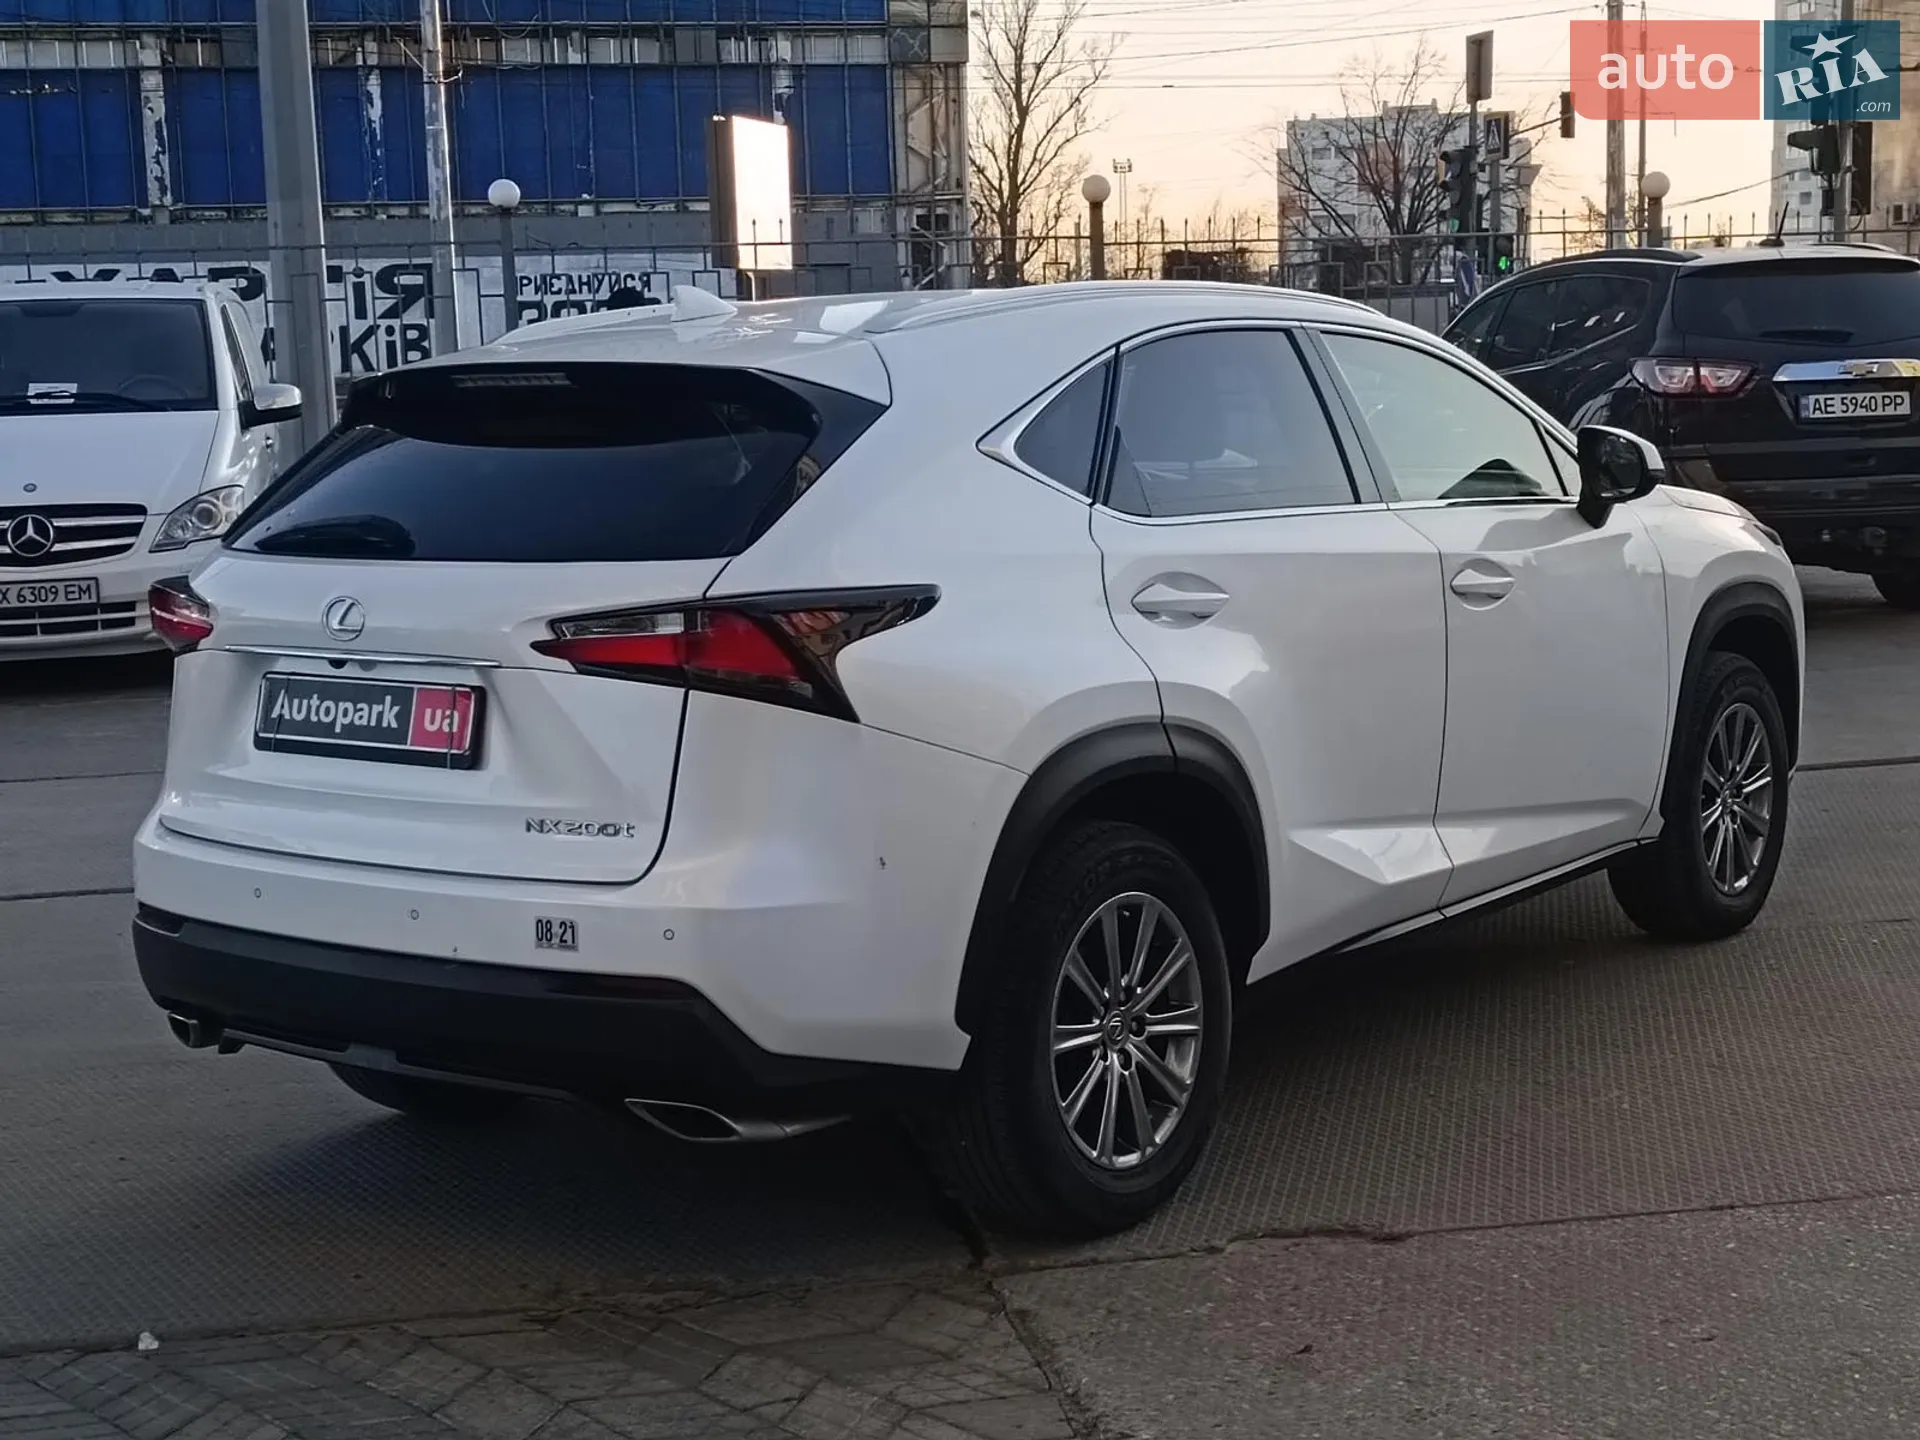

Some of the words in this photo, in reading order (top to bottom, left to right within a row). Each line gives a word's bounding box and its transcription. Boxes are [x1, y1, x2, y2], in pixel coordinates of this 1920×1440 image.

[1812, 397, 1836, 415] AE
[1841, 396, 1878, 414] 5940
[1882, 394, 1905, 412] PP
[16, 585, 59, 604] 6309
[64, 583, 92, 602] EM
[271, 688, 401, 733] Autopark
[423, 706, 460, 733] ua
[525, 817, 636, 838] NX200t
